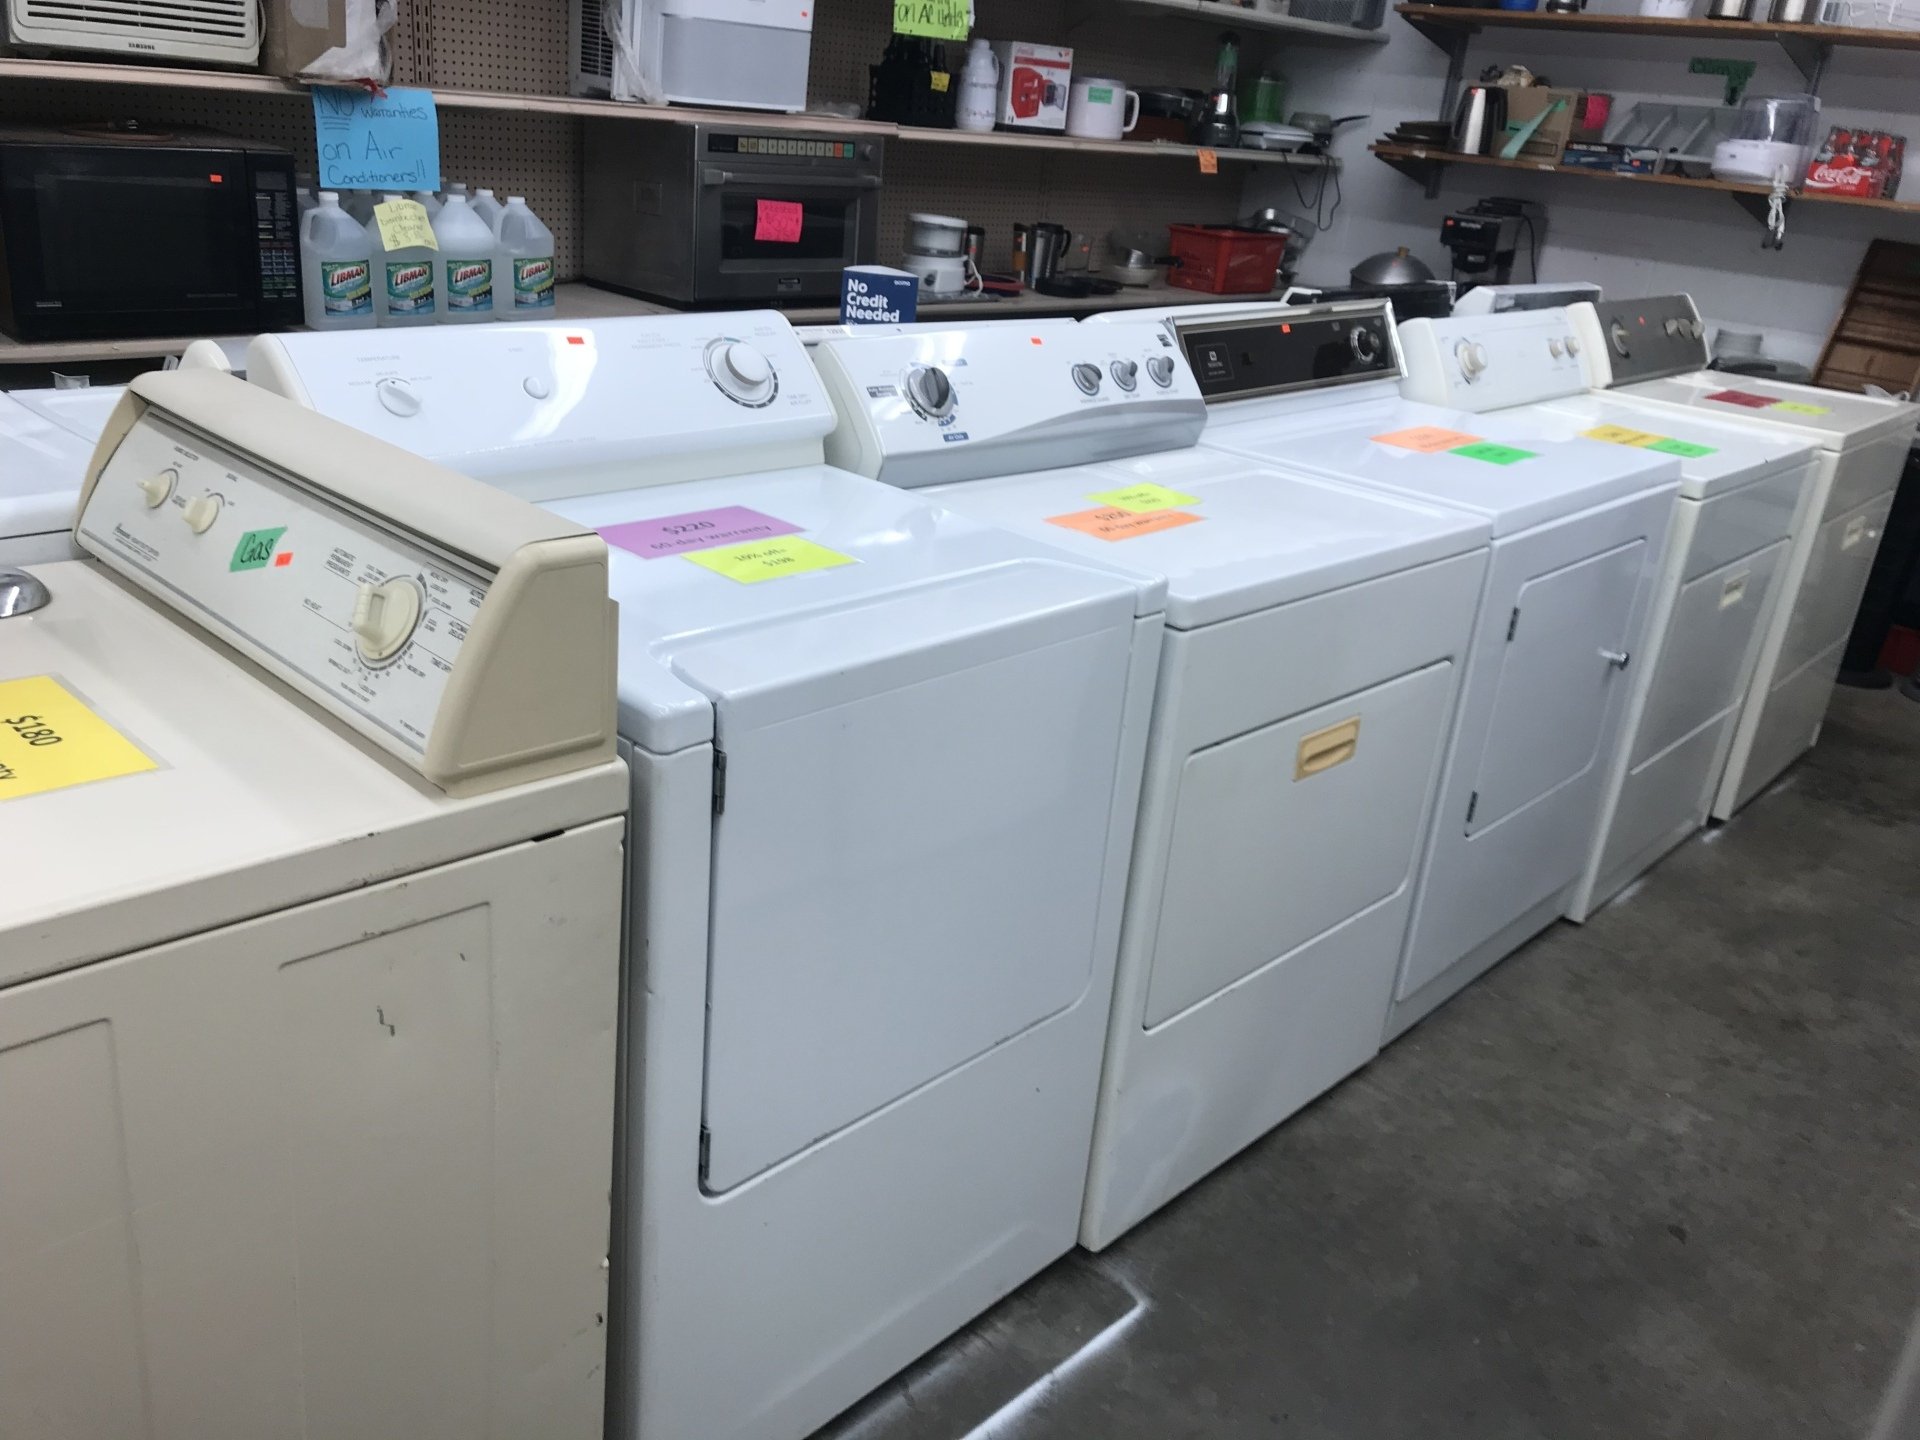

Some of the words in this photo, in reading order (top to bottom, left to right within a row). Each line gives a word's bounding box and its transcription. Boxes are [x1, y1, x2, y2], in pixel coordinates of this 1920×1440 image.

[322, 142, 351, 161] on
[366, 130, 403, 160] Air
[331, 266, 365, 287] LIBMAN
[394, 266, 427, 287] LIBMAN
[454, 263, 487, 284] LIBMAN
[521, 262, 549, 281] LIBMAN
[847, 278, 868, 294] No
[846, 292, 889, 309] Credit
[846, 304, 900, 323] Needed
[662, 521, 716, 536] $220
[240, 533, 274, 563] Gas
[0, 715, 63, 747] $180
